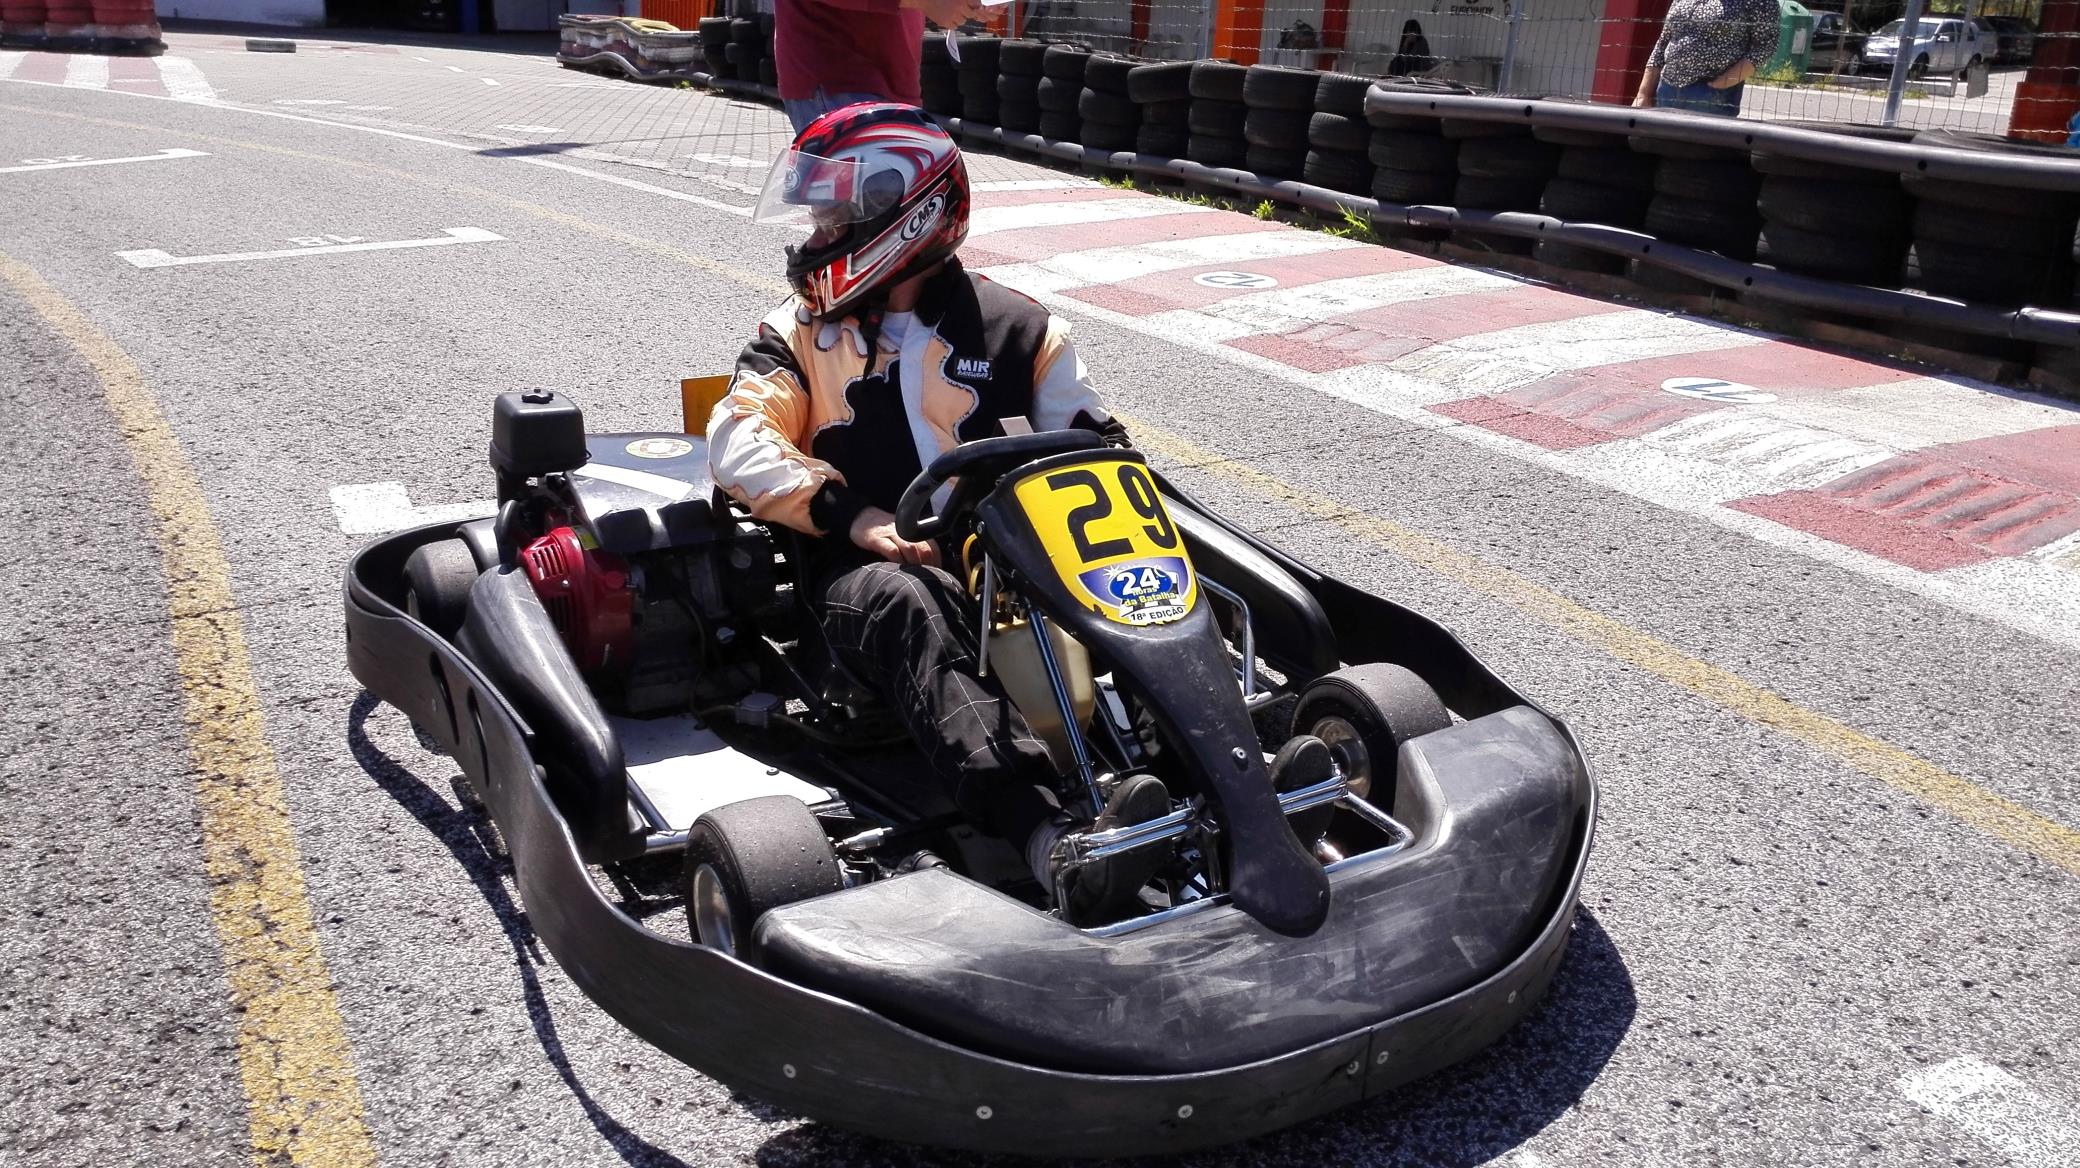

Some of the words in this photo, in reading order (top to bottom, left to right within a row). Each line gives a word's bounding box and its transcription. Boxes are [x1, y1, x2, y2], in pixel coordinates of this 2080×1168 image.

[909, 199, 937, 233] CMS
[957, 358, 990, 373] MIR
[1045, 464, 1178, 564] 29
[1116, 568, 1161, 596] 24
[1124, 597, 1138, 607] da
[1138, 591, 1177, 603] Batalha
[1149, 606, 1184, 620] EDIÇÃO
